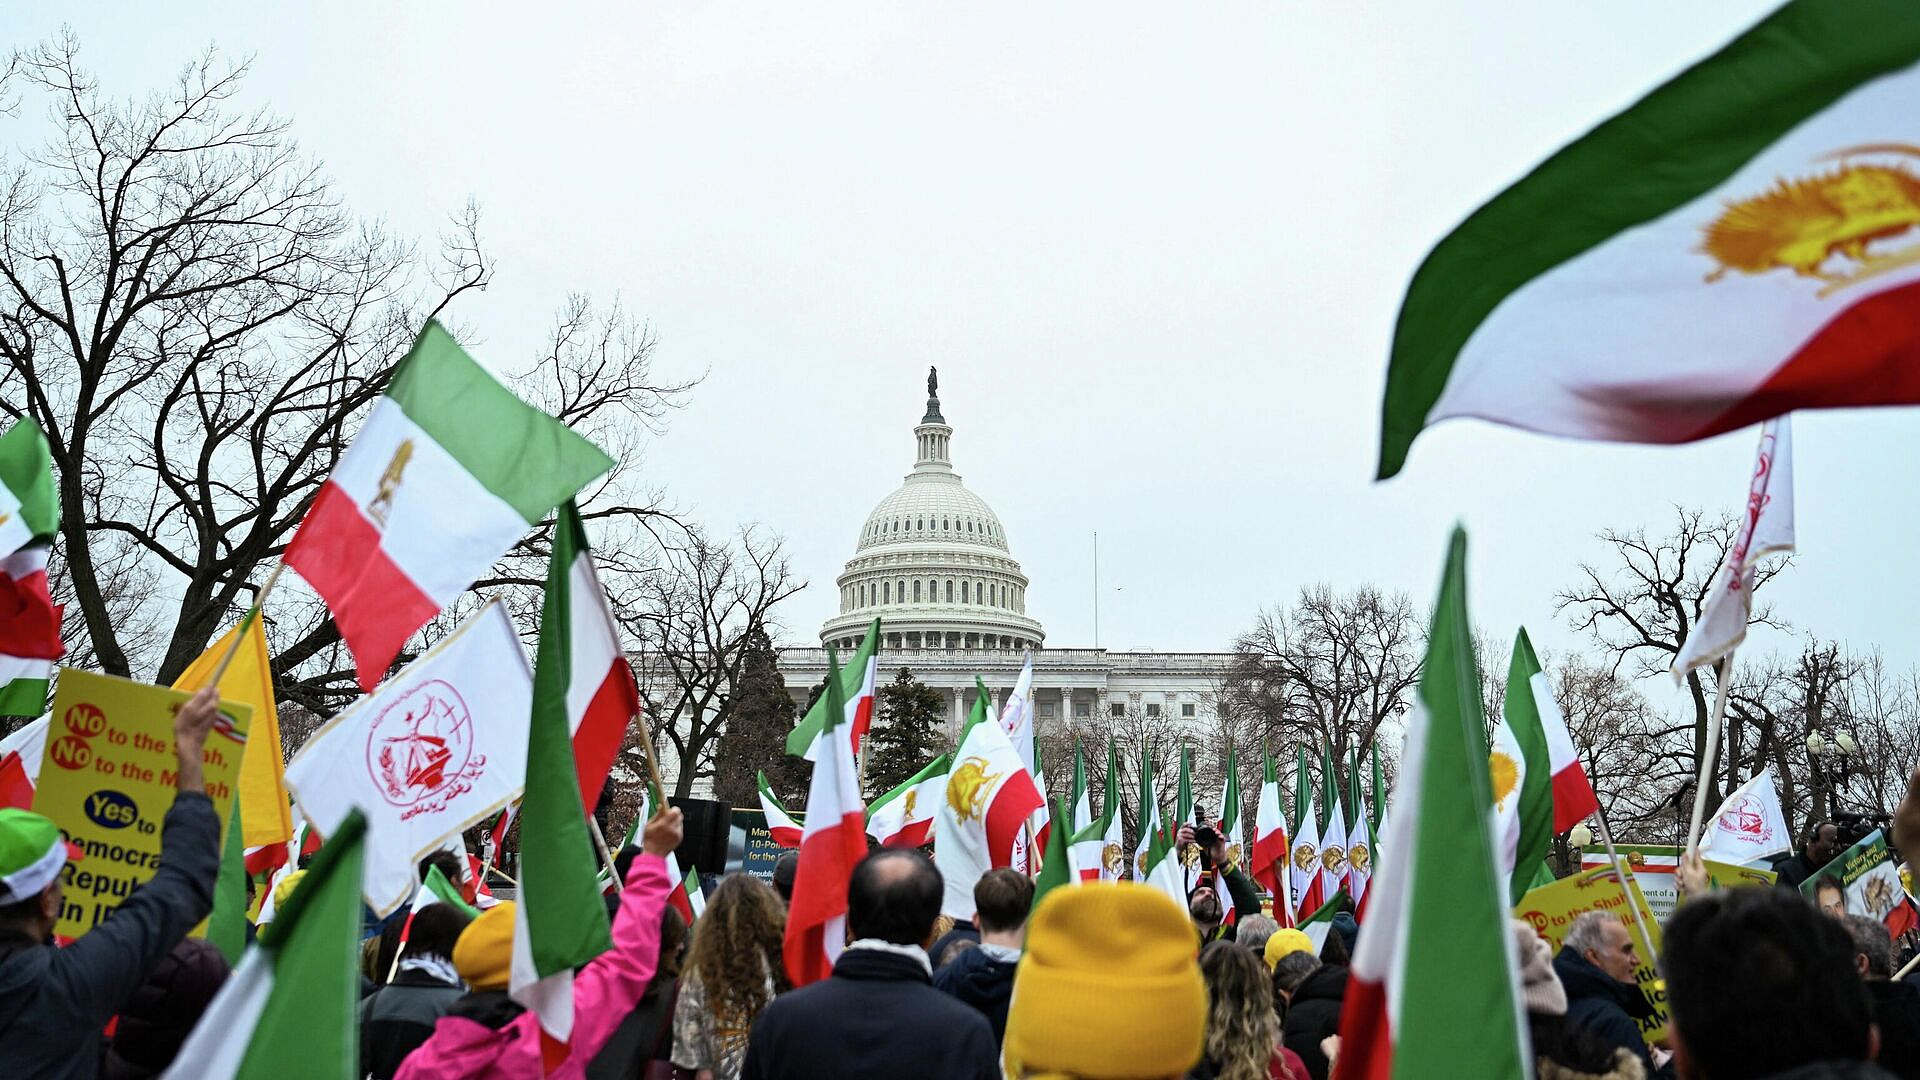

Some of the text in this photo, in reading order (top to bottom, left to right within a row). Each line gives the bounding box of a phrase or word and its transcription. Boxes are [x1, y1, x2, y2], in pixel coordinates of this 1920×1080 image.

[68, 705, 105, 735] No
[108, 728, 128, 745] to
[134, 732, 166, 753] the
[54, 739, 91, 766] No
[95, 758, 115, 774] to
[121, 762, 153, 782] the
[90, 793, 156, 834] Yes to
[751, 827, 772, 839] Mary
[58, 828, 161, 869] Democra
[749, 851, 761, 860] for
[762, 852, 776, 861] the
[1845, 843, 1878, 871] Victory and
[1842, 862, 1868, 886] Freedom
[1659, 889, 1668, 897] of
[58, 896, 83, 922] in
[1551, 914, 1566, 927] to
